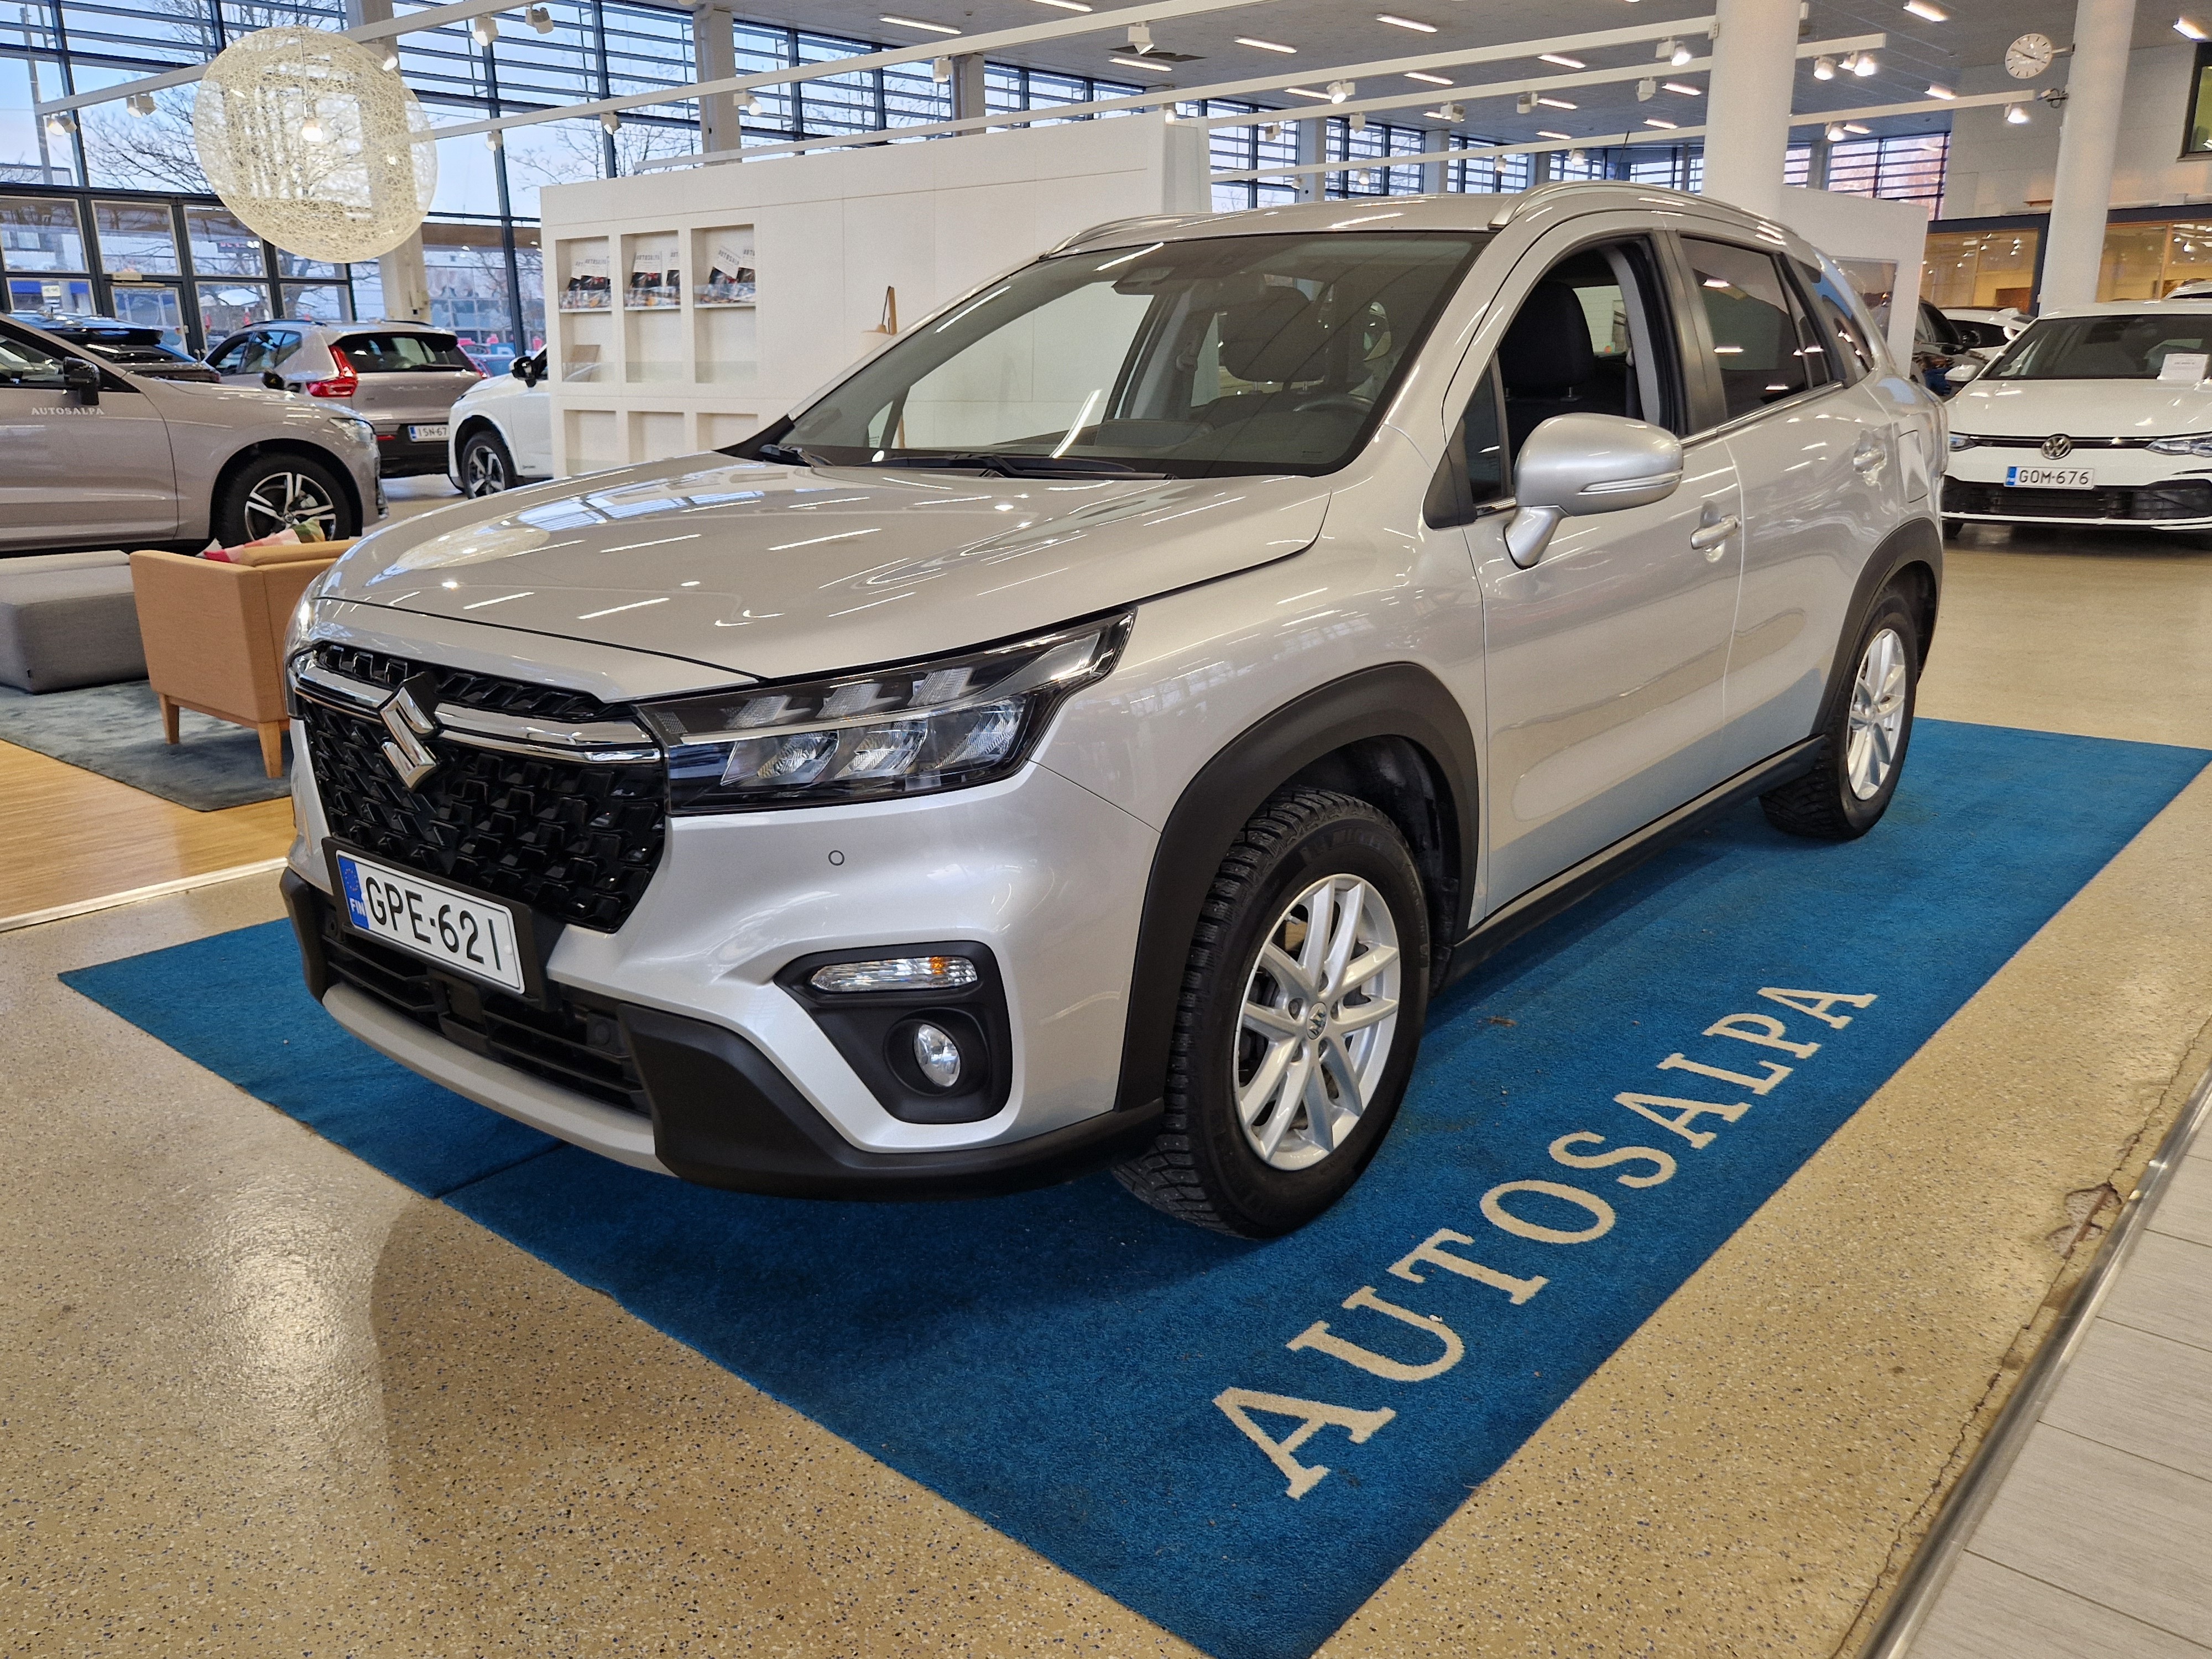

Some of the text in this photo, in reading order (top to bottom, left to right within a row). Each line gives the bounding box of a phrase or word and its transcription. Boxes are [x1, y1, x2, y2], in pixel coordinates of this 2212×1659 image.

[31, 407, 105, 415] AUTOSALPA
[418, 427, 448, 437] ISN-67
[2019, 470, 2089, 485] GOM-676
[349, 897, 367, 917] FIN
[366, 877, 502, 971] GPE-621
[1212, 985, 1878, 1500] AUTOSALPA
